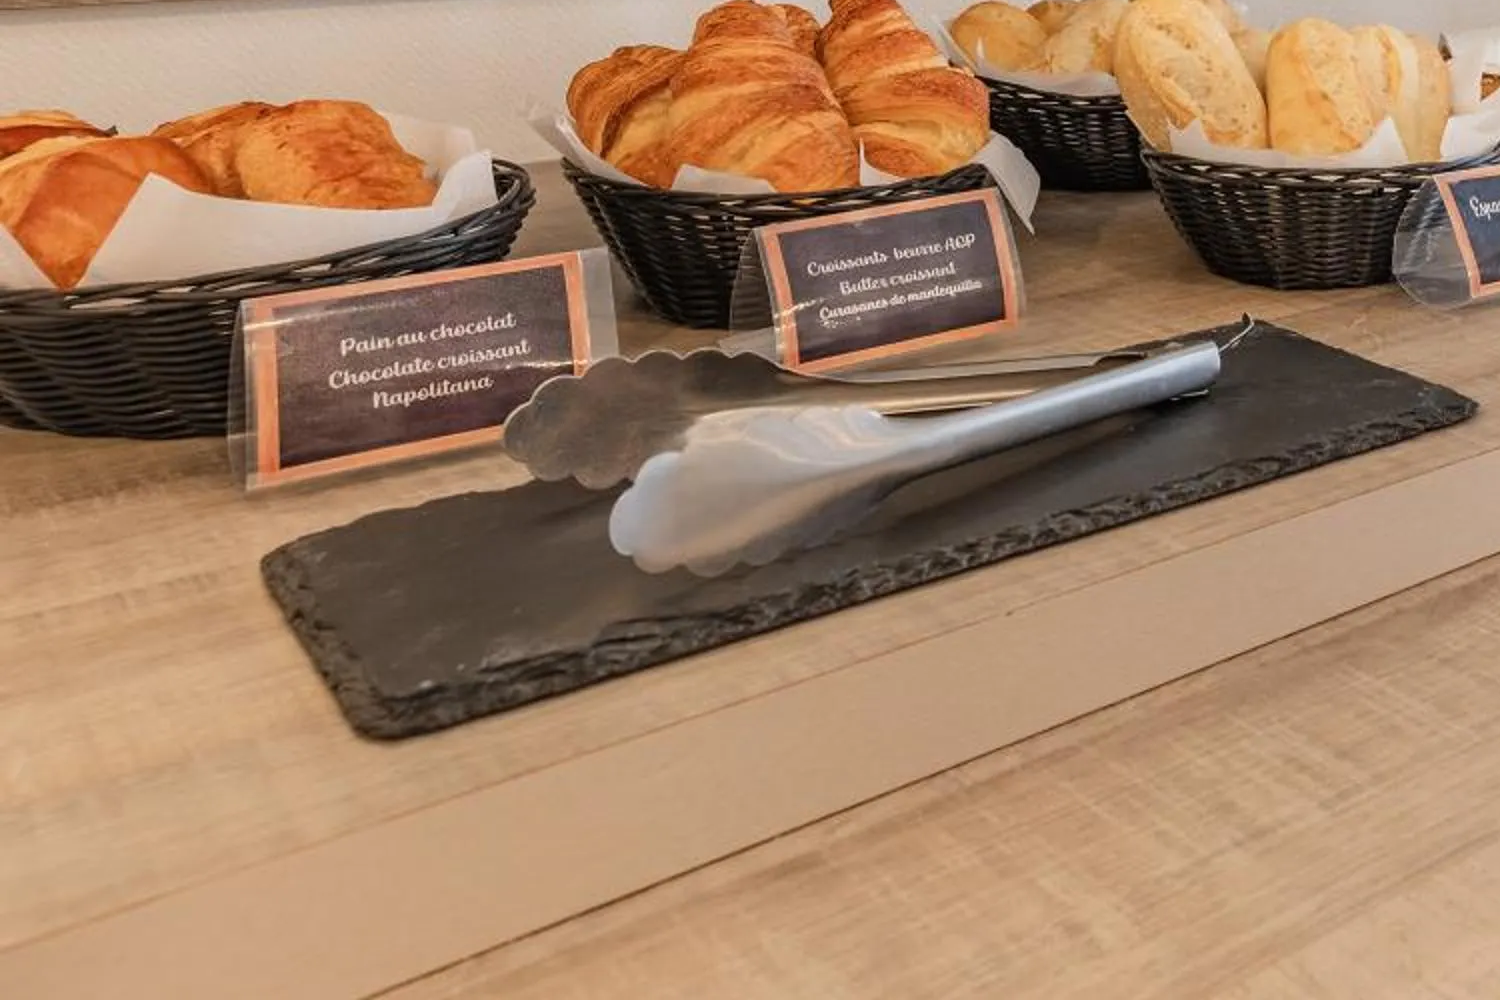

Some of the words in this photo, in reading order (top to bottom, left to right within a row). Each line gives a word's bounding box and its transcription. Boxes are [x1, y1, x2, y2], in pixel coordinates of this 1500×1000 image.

[807, 250, 890, 276] Croissants
[893, 243, 943, 260] beurre
[840, 276, 888, 295] Butter
[890, 262, 956, 286] croissant
[889, 292, 907, 305] de
[340, 336, 394, 356] Pain
[397, 331, 427, 345] au
[430, 312, 516, 340] chocolat
[329, 357, 435, 389] Chocolate
[438, 339, 531, 368] croissant
[373, 376, 494, 408] Napolitana
